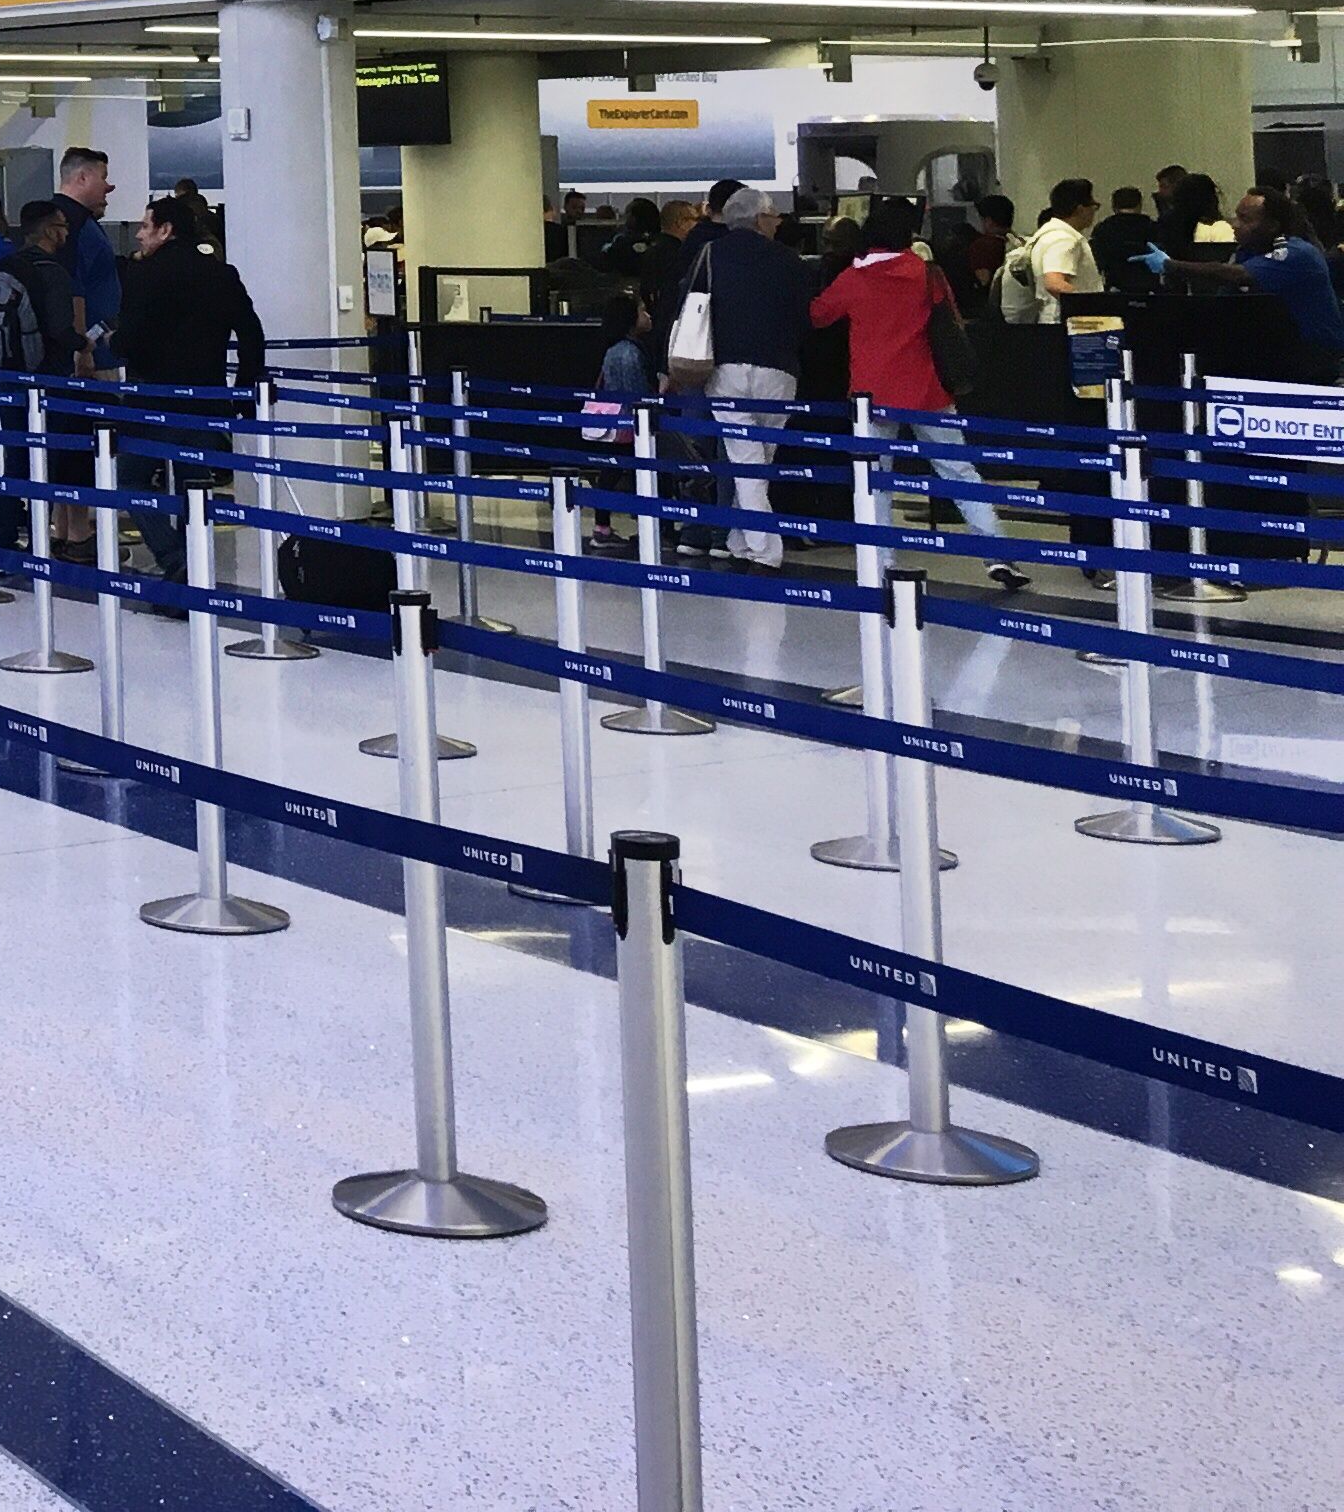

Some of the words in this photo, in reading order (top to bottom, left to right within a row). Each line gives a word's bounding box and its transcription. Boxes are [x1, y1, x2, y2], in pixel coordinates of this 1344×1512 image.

[1247, 417, 1271, 432] DO
[1275, 420, 1310, 436] NOT
[216, 509, 239, 517] UNITED
[663, 506, 689, 514] UNITED
[310, 525, 334, 534] UNITED
[779, 522, 808, 530] UNITED
[1262, 522, 1294, 530] UNITED
[903, 536, 934, 544] UNITED
[413, 542, 440, 551] UNITED
[1041, 550, 1075, 558] UNITED
[525, 559, 554, 568] UNITED
[1190, 563, 1227, 571] UNITED
[648, 574, 679, 583] UNITED
[785, 589, 820, 598] UNITED
[209, 599, 235, 608] UNITED
[319, 615, 346, 624] UNITED
[1000, 619, 1038, 632] UNITED
[1171, 650, 1215, 663] UNITED
[565, 661, 602, 677] UNITED
[723, 698, 762, 714] UNITED
[8, 720, 38, 736] UNITED
[903, 736, 948, 753] UNITED
[136, 760, 171, 776] UNITED
[1109, 773, 1161, 791] UNITED
[286, 803, 325, 820] UNITED
[463, 846, 508, 866] UNITED
[850, 956, 915, 985] UNITED
[1152, 1047, 1231, 1082] UNITED
